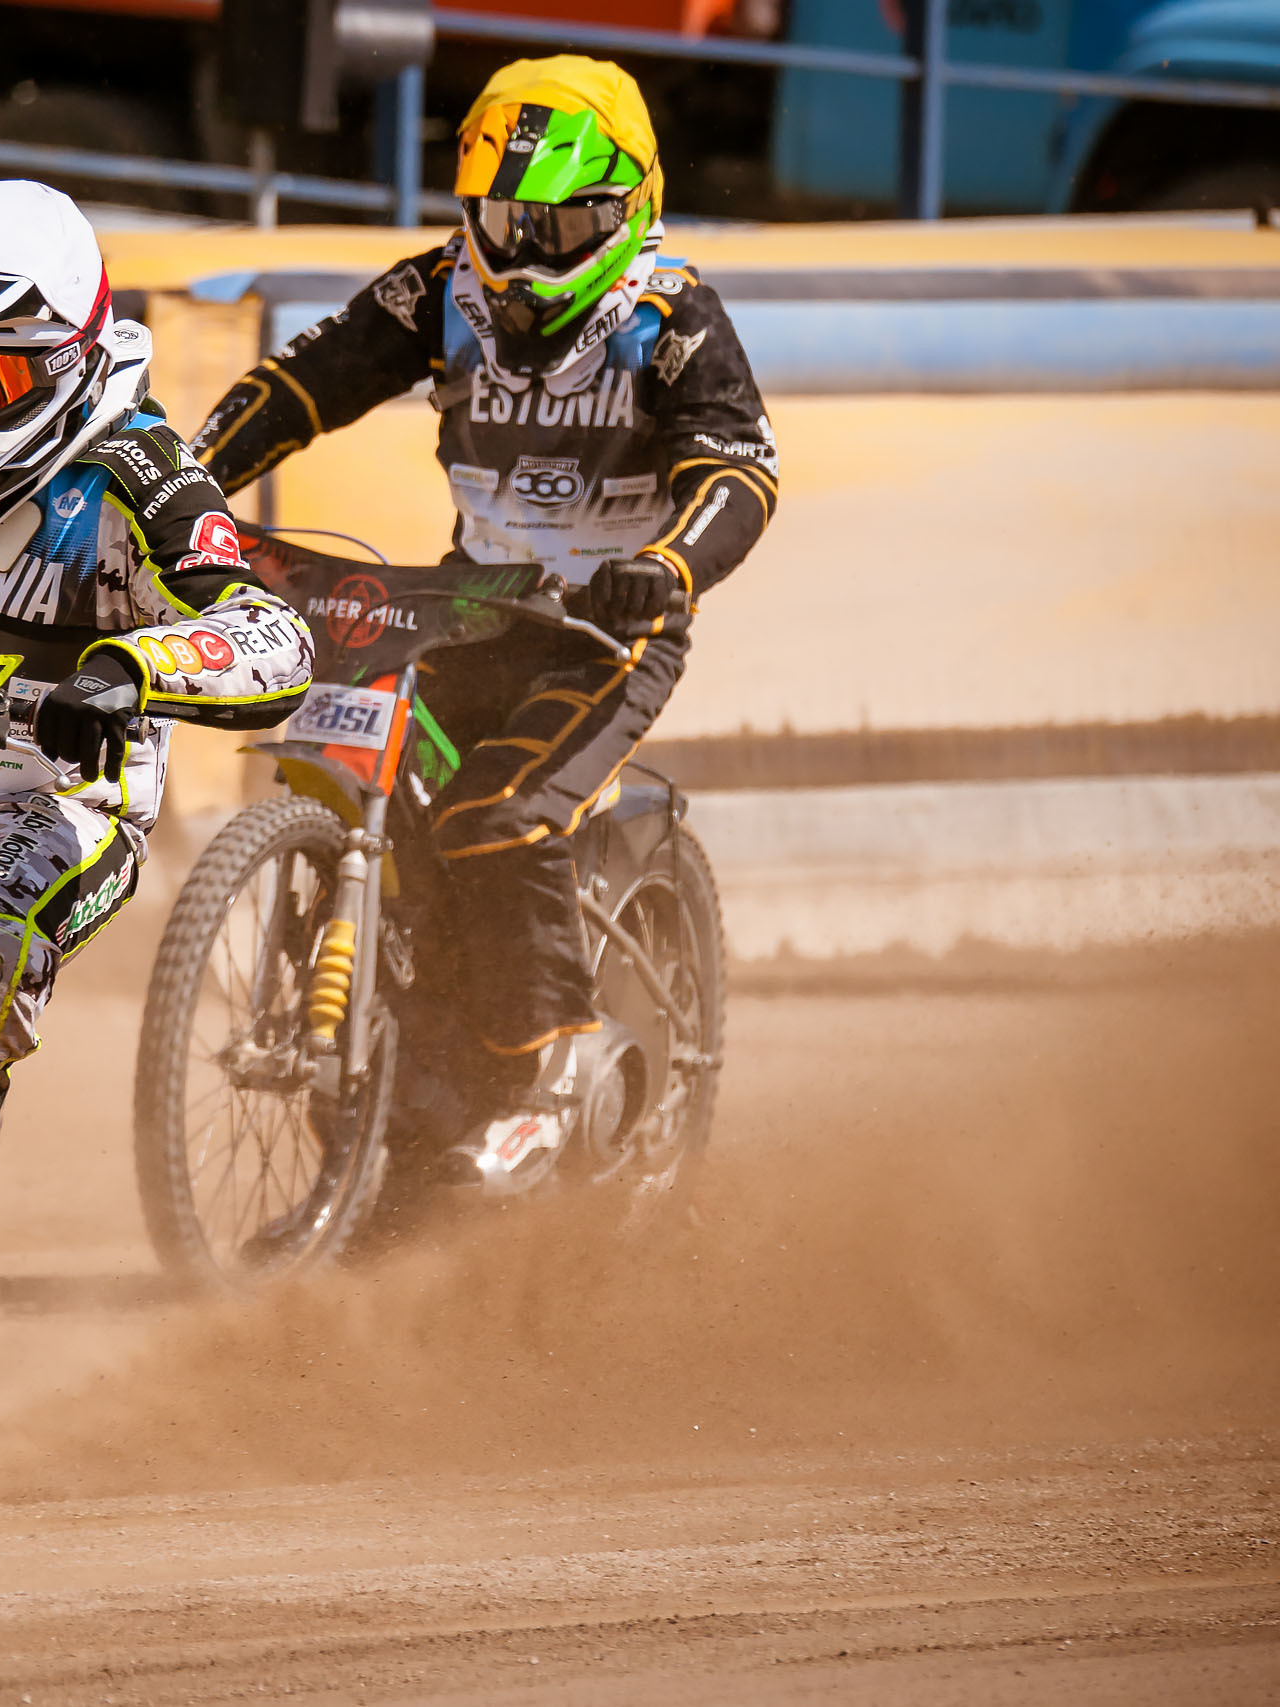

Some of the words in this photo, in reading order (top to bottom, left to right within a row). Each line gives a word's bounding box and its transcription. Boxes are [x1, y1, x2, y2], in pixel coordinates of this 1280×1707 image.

[575, 302, 622, 353] LEATT
[50, 346, 78, 371] 100%
[511, 471, 578, 498] 360
[307, 597, 362, 620] PAPER
[367, 605, 419, 631] MILL
[230, 619, 294, 656] RENT
